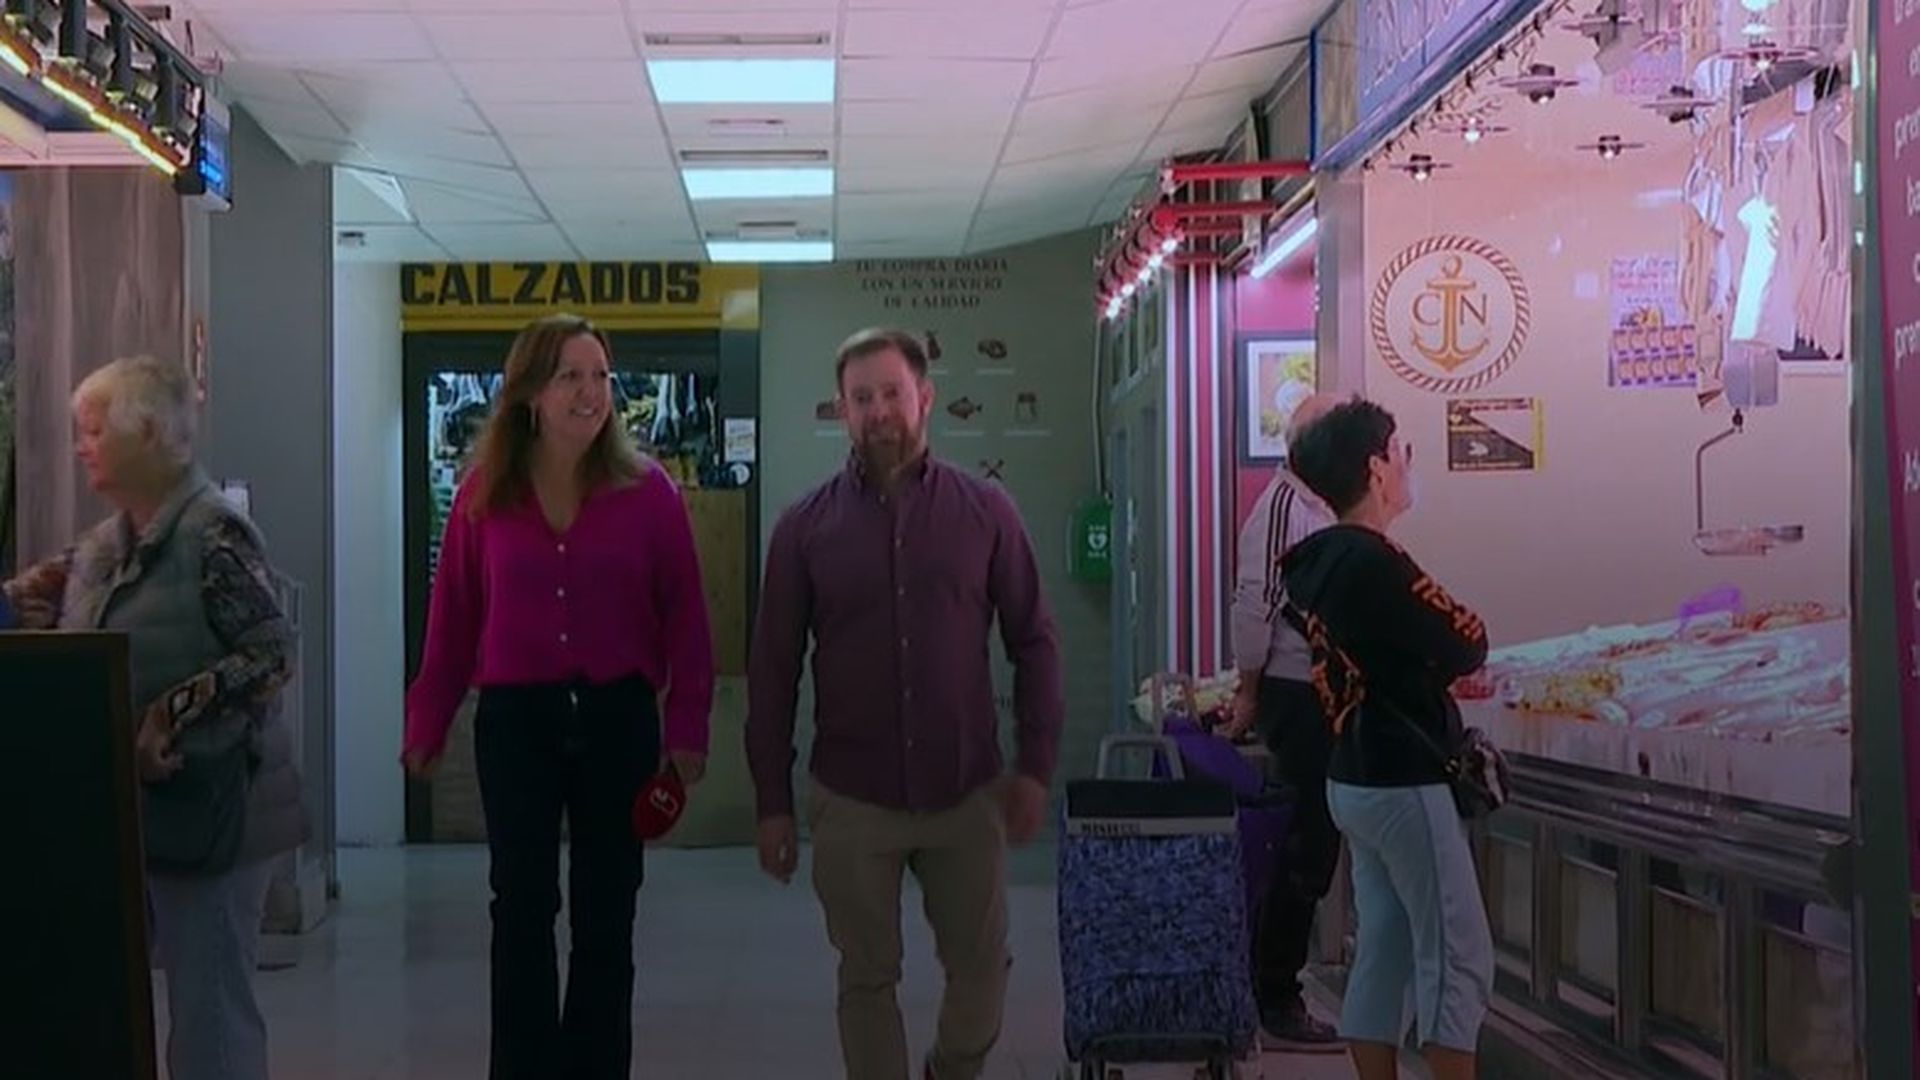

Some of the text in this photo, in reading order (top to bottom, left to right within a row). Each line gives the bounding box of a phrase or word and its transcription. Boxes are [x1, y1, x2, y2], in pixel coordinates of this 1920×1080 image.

[954, 257, 1008, 272] DIARIA
[401, 262, 700, 304] CALZADOS
[911, 296, 980, 308] CALIDAD
